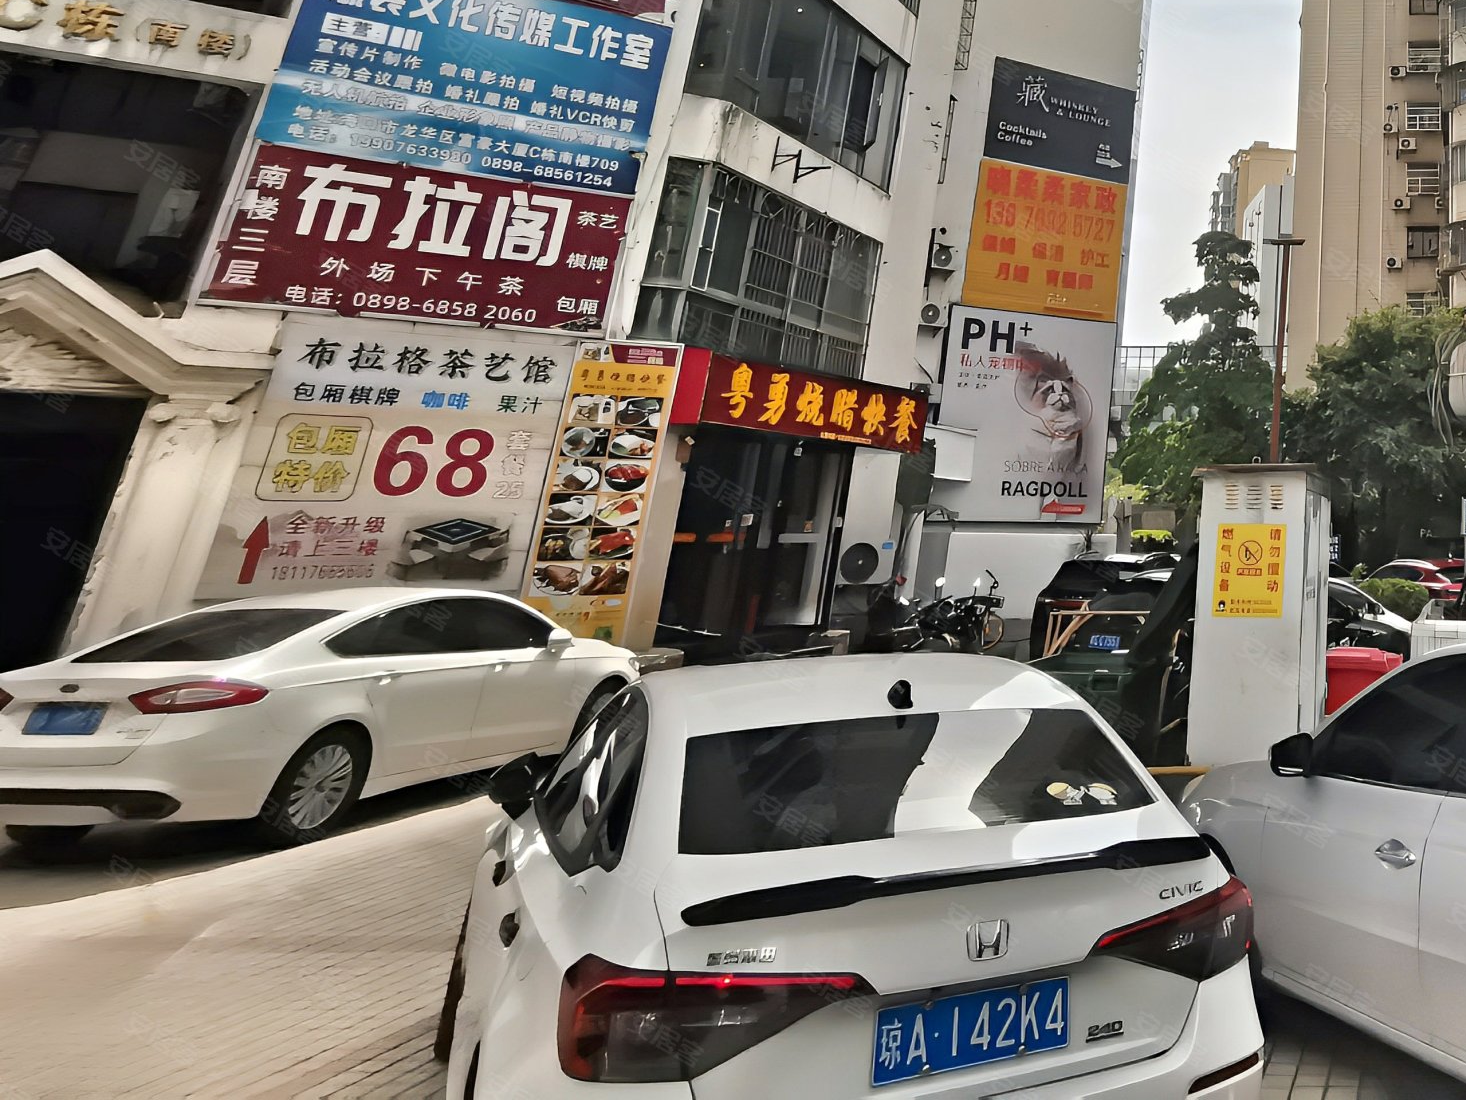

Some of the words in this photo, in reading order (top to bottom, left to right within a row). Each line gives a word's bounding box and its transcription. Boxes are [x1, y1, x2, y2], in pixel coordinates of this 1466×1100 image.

[315, 38, 424, 70] 宣传片制作
[1016, 75, 1050, 113] 藏
[1050, 96, 1100, 115] WHISKEY
[998, 121, 1048, 140] Cocktails
[1068, 111, 1111, 128] LOUNGE
[997, 131, 1034, 147] Coffee
[480, 155, 613, 188] 0898-68561254
[221, 164, 291, 287] 南楼三层
[296, 162, 574, 268] 布拉阁
[576, 209, 620, 231] 茶艺
[565, 251, 610, 273] 棋牌
[319, 256, 528, 296] 外场下午茶
[483, 304, 537, 324] 2060
[556, 294, 601, 317] 包厢
[297, 337, 559, 386] 布拉格茶艺馆
[293, 382, 401, 407] 包厢棋牌
[421, 390, 471, 410] 咖啡
[497, 395, 544, 415] 果汁
[720, 362, 918, 444] 粤勇烧腊快餐
[286, 422, 363, 456] 包厢
[373, 425, 496, 498] 68
[271, 458, 350, 494] 特价
[1001, 480, 1088, 498] RAGDOLL
[286, 514, 386, 535] 全新升级
[278, 539, 379, 558] 请上三楼
[1159, 880, 1204, 900] CIVIC
